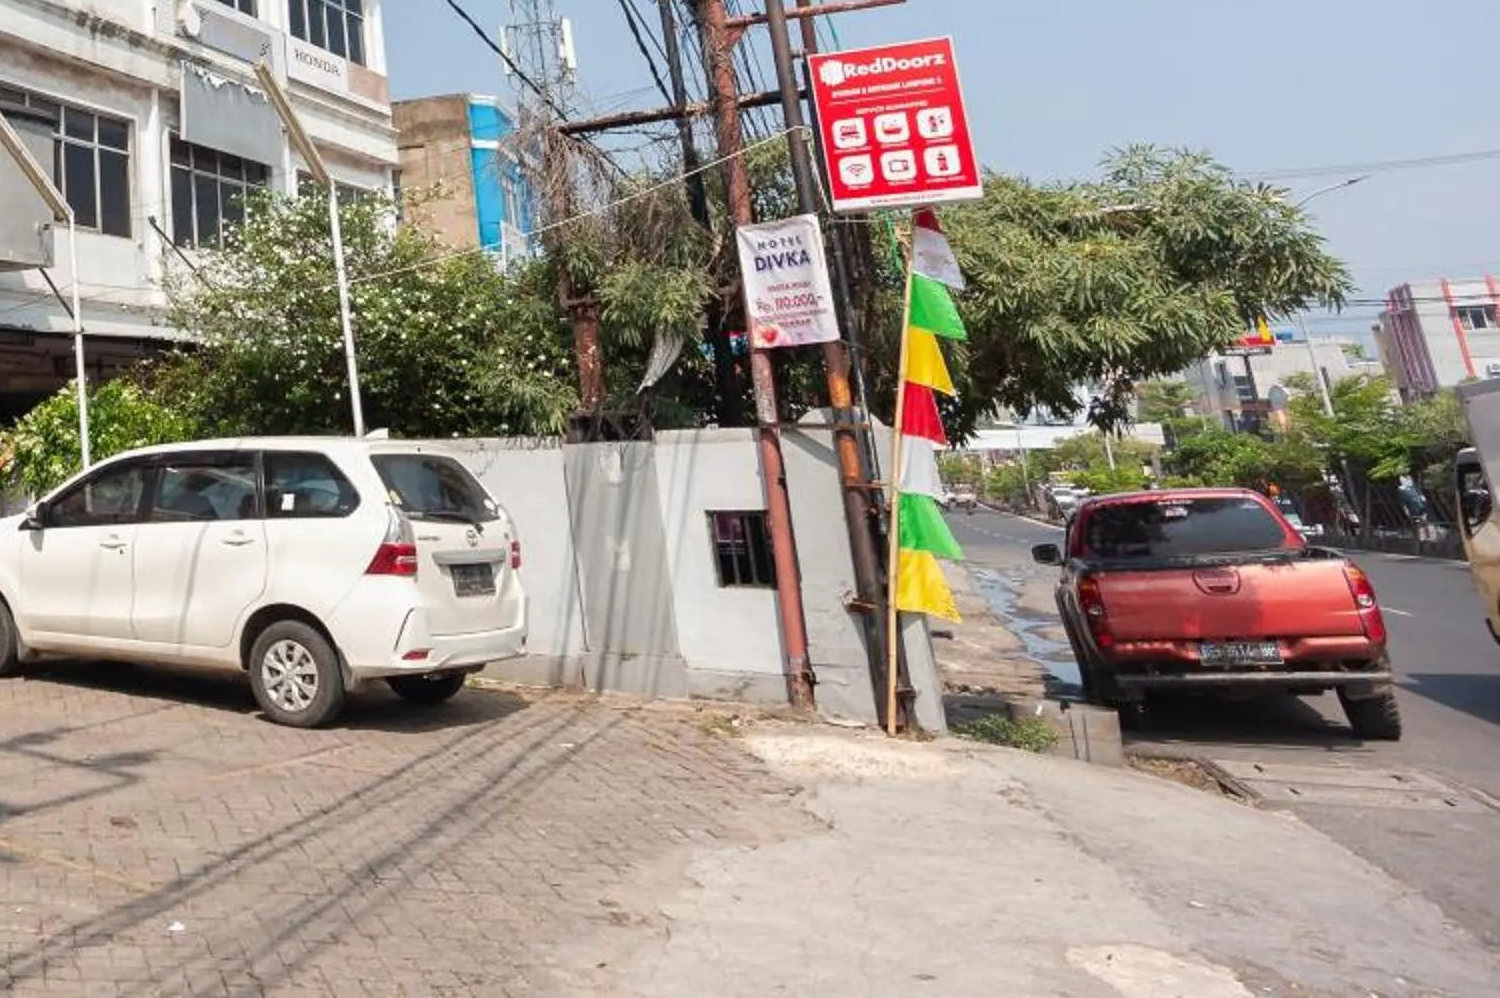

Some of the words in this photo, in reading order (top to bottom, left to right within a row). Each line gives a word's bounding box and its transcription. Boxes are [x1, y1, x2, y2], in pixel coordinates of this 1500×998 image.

[843, 53, 946, 79] RedDoorz
[757, 235, 802, 251] HOTEL
[754, 249, 811, 272] DIVKA
